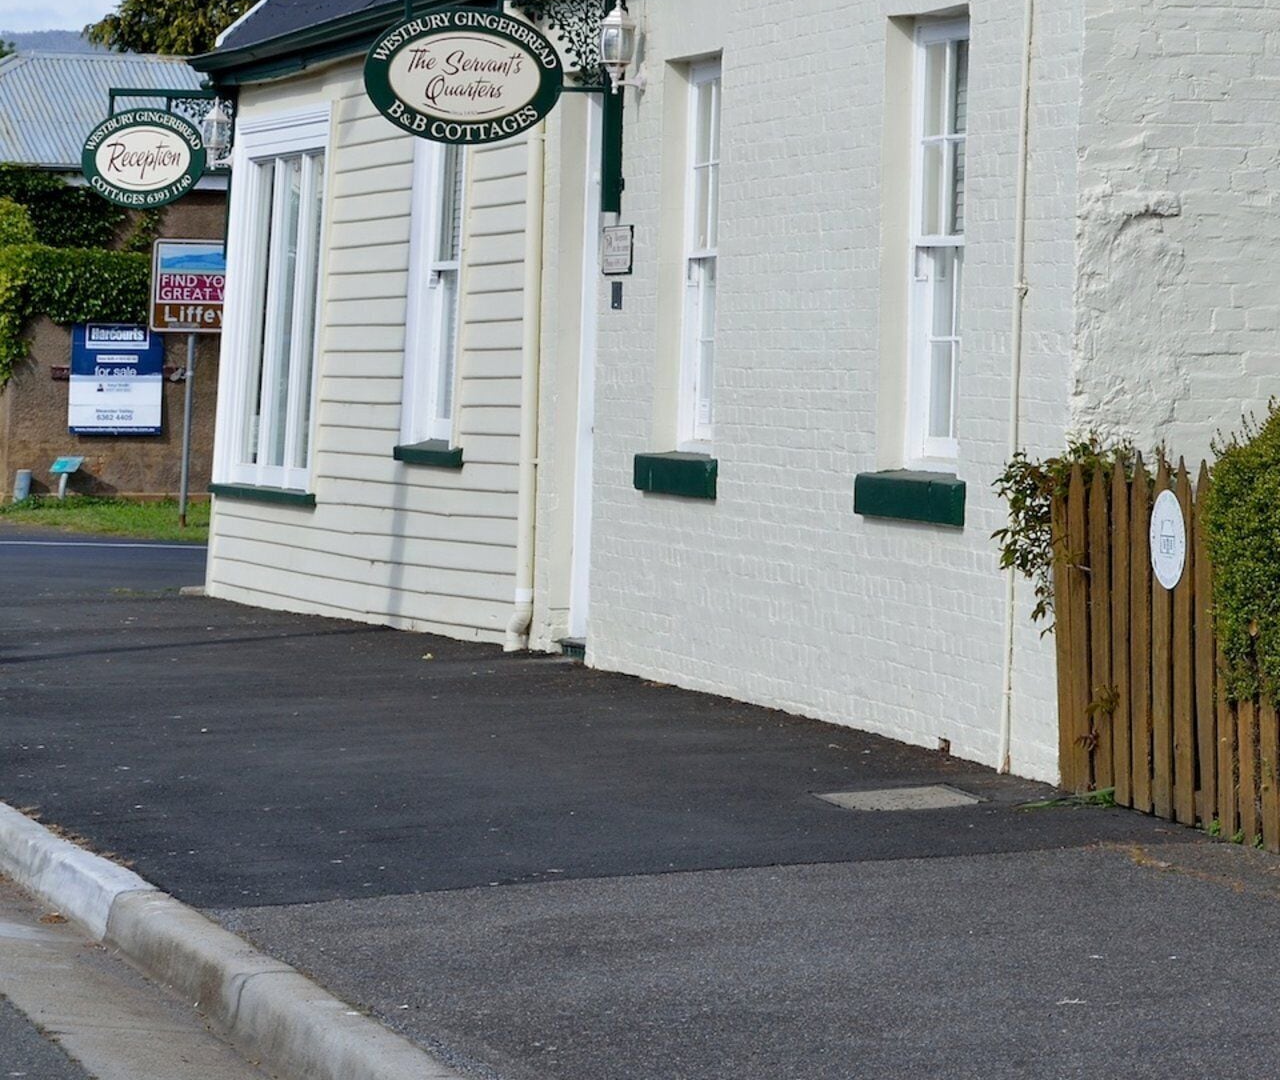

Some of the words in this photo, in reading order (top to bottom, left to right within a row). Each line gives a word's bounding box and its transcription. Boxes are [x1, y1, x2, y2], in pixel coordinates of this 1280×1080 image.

[372, 12, 451, 61] WESTBURY
[454, 11, 557, 69] GINGERBREAD
[407, 47, 437, 73] The
[441, 49, 525, 77] Servant's
[424, 74, 504, 106] Quarters
[85, 112, 135, 150] WESTBURY
[135, 111, 201, 151] GINGERBREAD
[387, 99, 427, 132] B&B
[431, 104, 539, 141] COTTAGES
[107, 140, 181, 180] Reception
[91, 175, 145, 204] COTTAGES
[146, 189, 170, 204] 6393
[171, 174, 193, 196] 1140
[161, 274, 198, 287] FIND
[203, 275, 225, 288] YO
[161, 287, 213, 300] GREAT
[91, 327, 144, 341] Harcourts
[94, 366, 111, 376] for
[113, 366, 137, 376] sale
